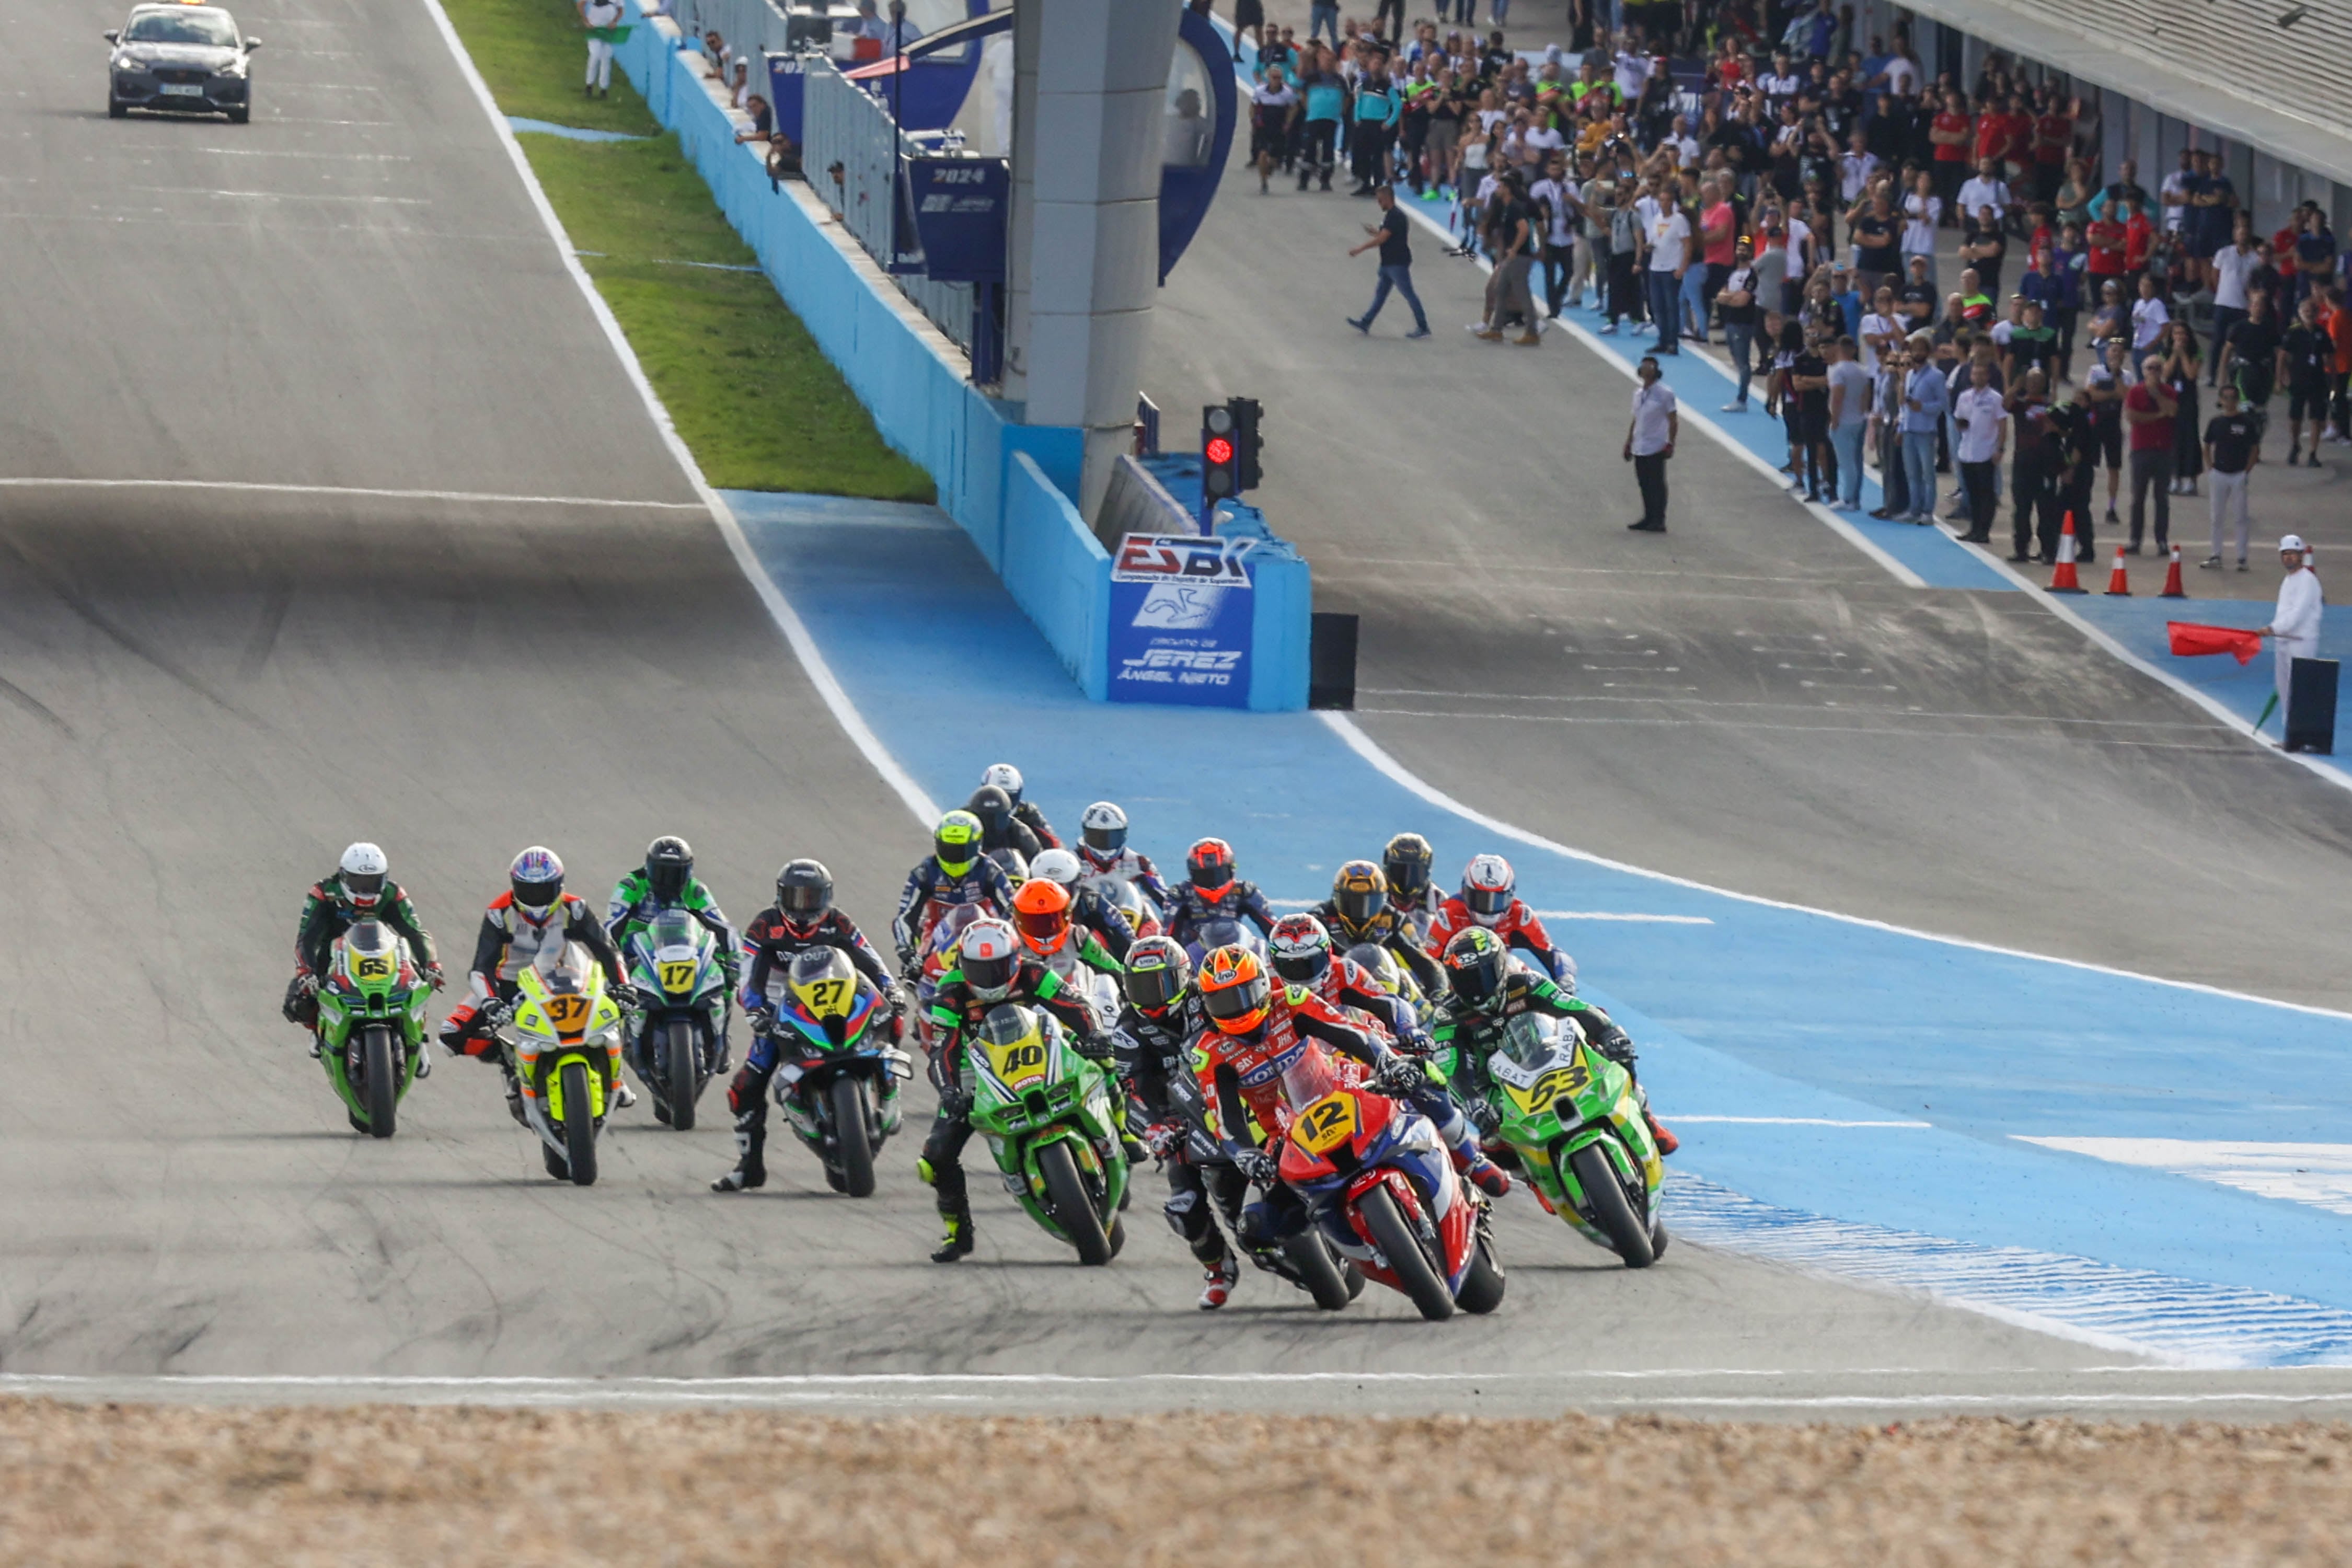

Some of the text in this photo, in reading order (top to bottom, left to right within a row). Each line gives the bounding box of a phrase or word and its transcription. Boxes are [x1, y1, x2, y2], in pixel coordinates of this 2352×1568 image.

[932, 168, 985, 183] 2024
[1122, 649, 1242, 670] JEREZ
[1117, 666, 1231, 685] ÁNGEL NIETO
[359, 958, 388, 977] 65
[664, 966, 694, 986] 17
[1217, 970, 1236, 981] Arai
[813, 980, 845, 1007] 27
[550, 997, 587, 1022] 37
[1002, 1045, 1043, 1077] 40
[1014, 1075, 1044, 1091] MOTUL
[1529, 1066, 1588, 1113] 53
[1301, 1101, 1350, 1142] 12
